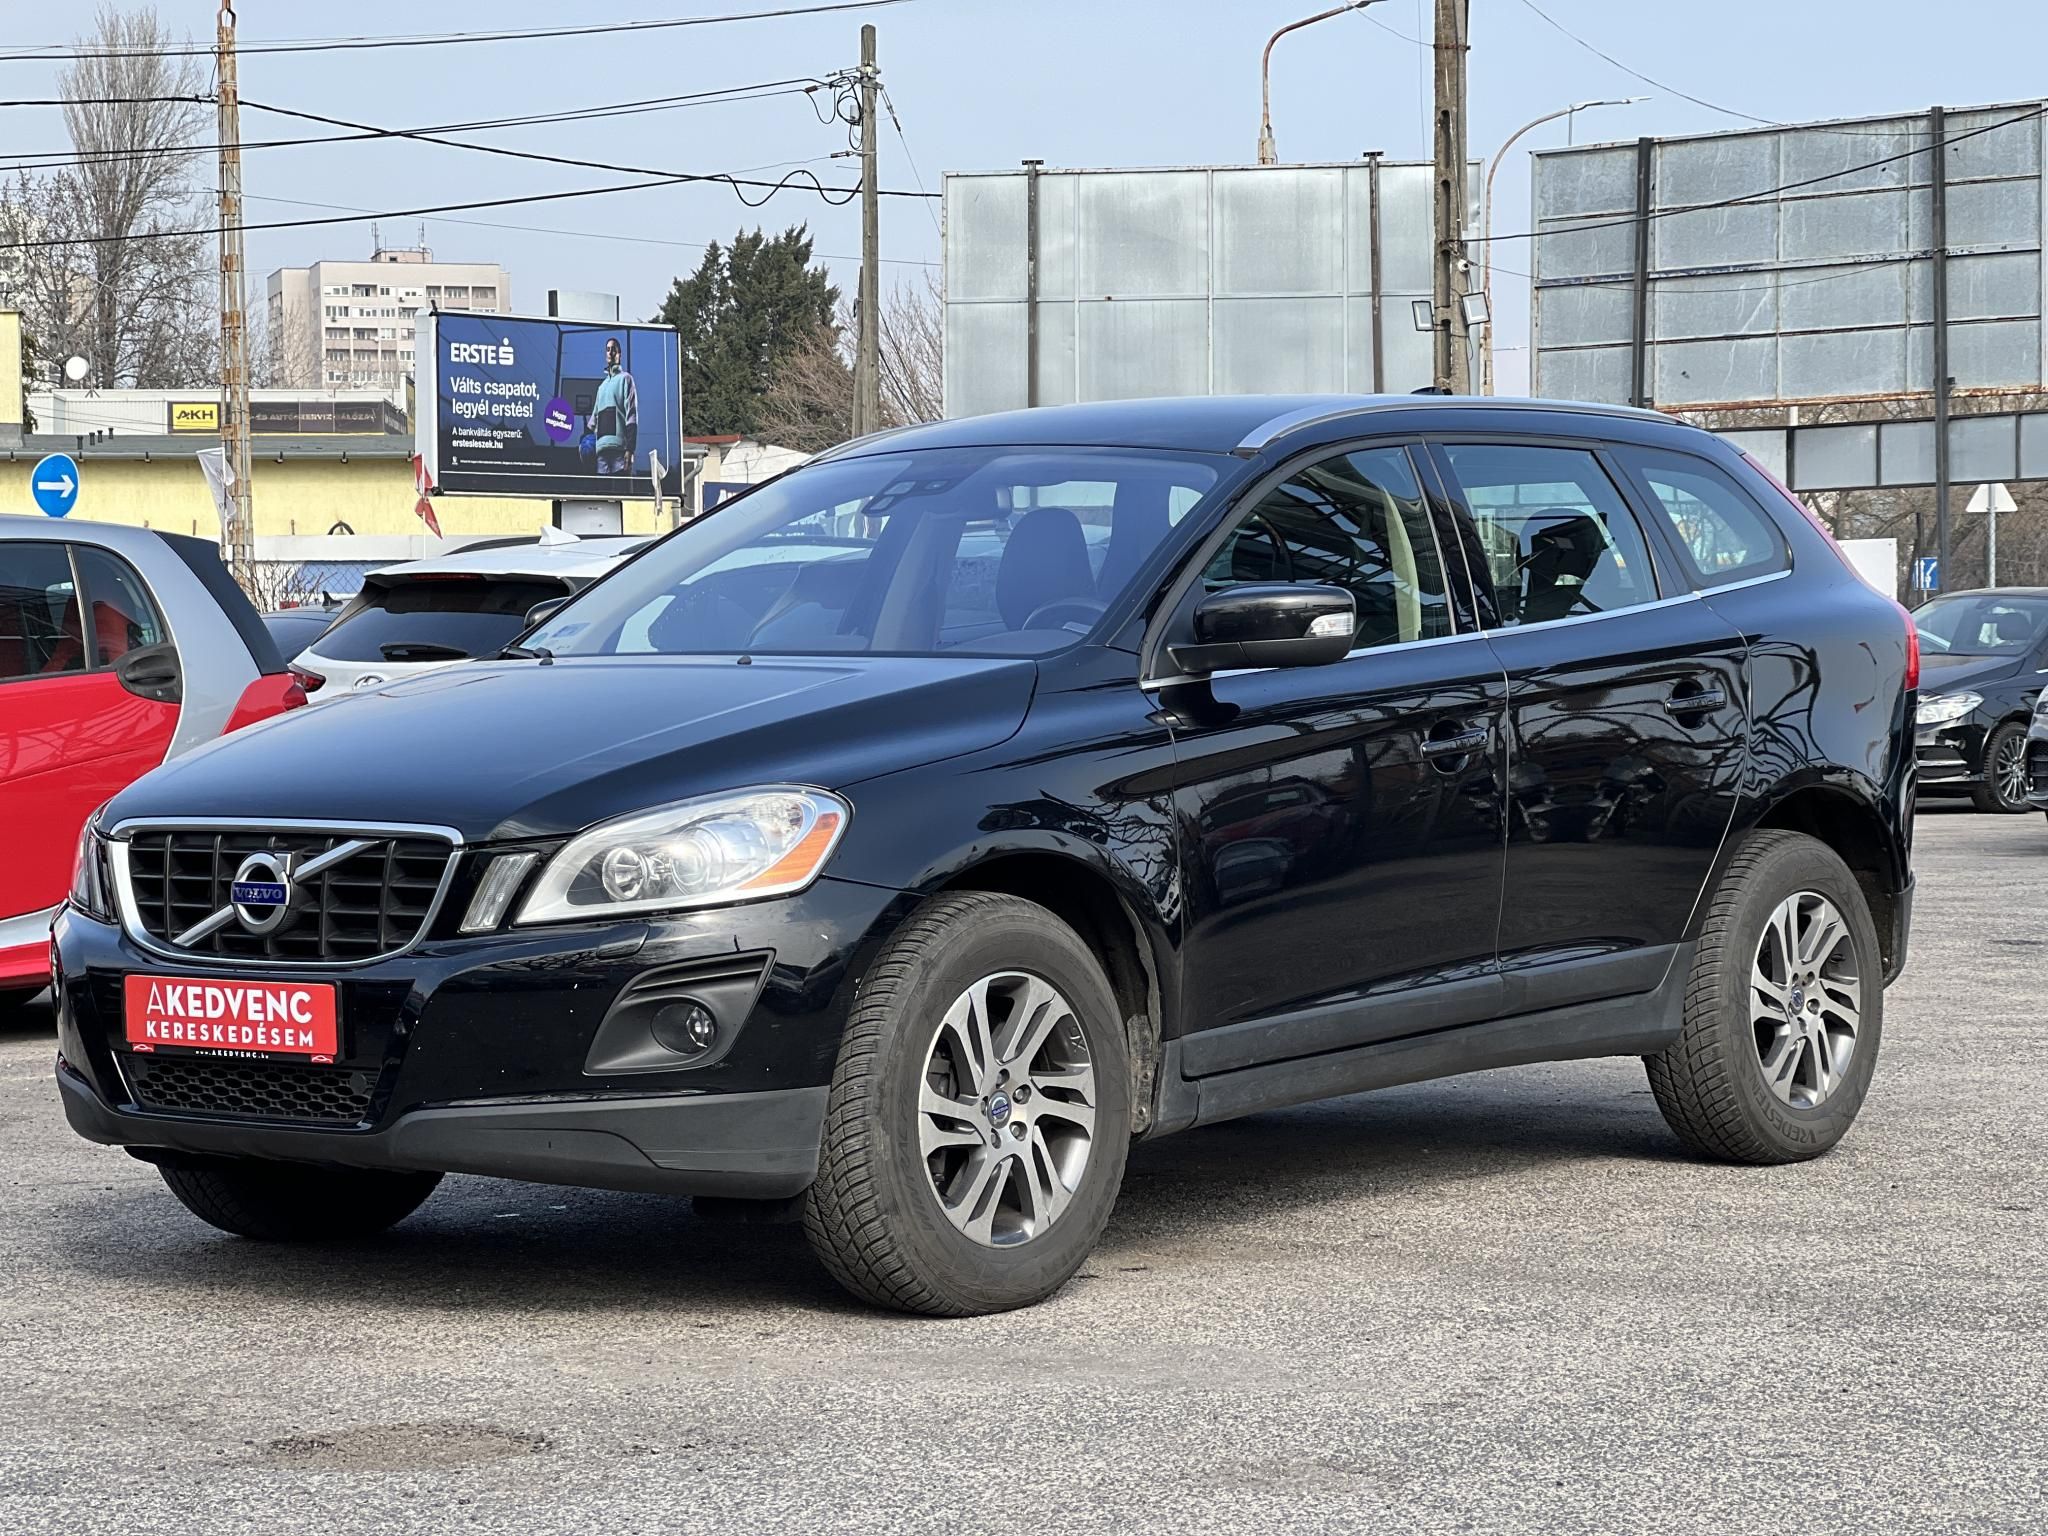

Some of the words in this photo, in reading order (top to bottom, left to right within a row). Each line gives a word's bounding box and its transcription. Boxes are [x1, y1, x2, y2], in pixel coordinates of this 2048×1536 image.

[450, 342, 497, 365] ERSTE
[450, 376, 482, 394] Válts
[484, 381, 540, 401] csapatot,
[175, 409, 214, 420] AKH
[452, 398, 489, 419] legyél
[491, 401, 533, 418] erstés!
[452, 426, 458, 436] A
[458, 426, 492, 438] bankváltás
[492, 428, 523, 440] egyszerű:
[452, 438, 504, 450] erstesleszek.hu
[233, 886, 283, 900] VOLVO
[146, 981, 313, 1025] AKEDVENC
[146, 1020, 314, 1047] KERESKEDÉSEM
[1749, 1074, 1817, 1144] VREDESTEIN
